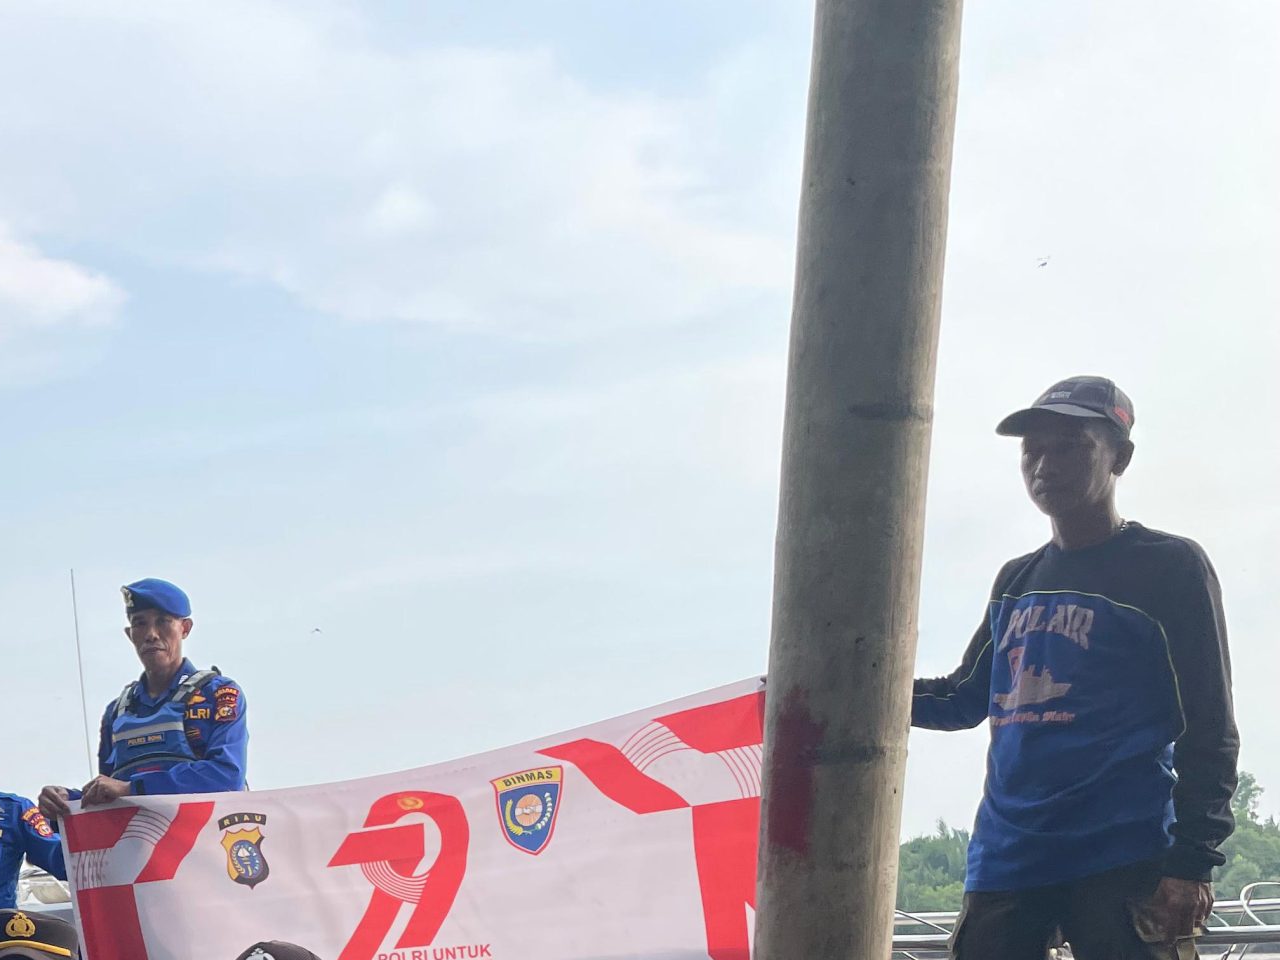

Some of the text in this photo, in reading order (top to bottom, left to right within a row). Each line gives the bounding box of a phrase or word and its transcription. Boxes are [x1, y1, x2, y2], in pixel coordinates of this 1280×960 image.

[185, 708, 209, 719] LRI
[502, 770, 553, 787] BINMAS
[223, 814, 262, 826] RIAU
[433, 944, 492, 960] UNTUK
